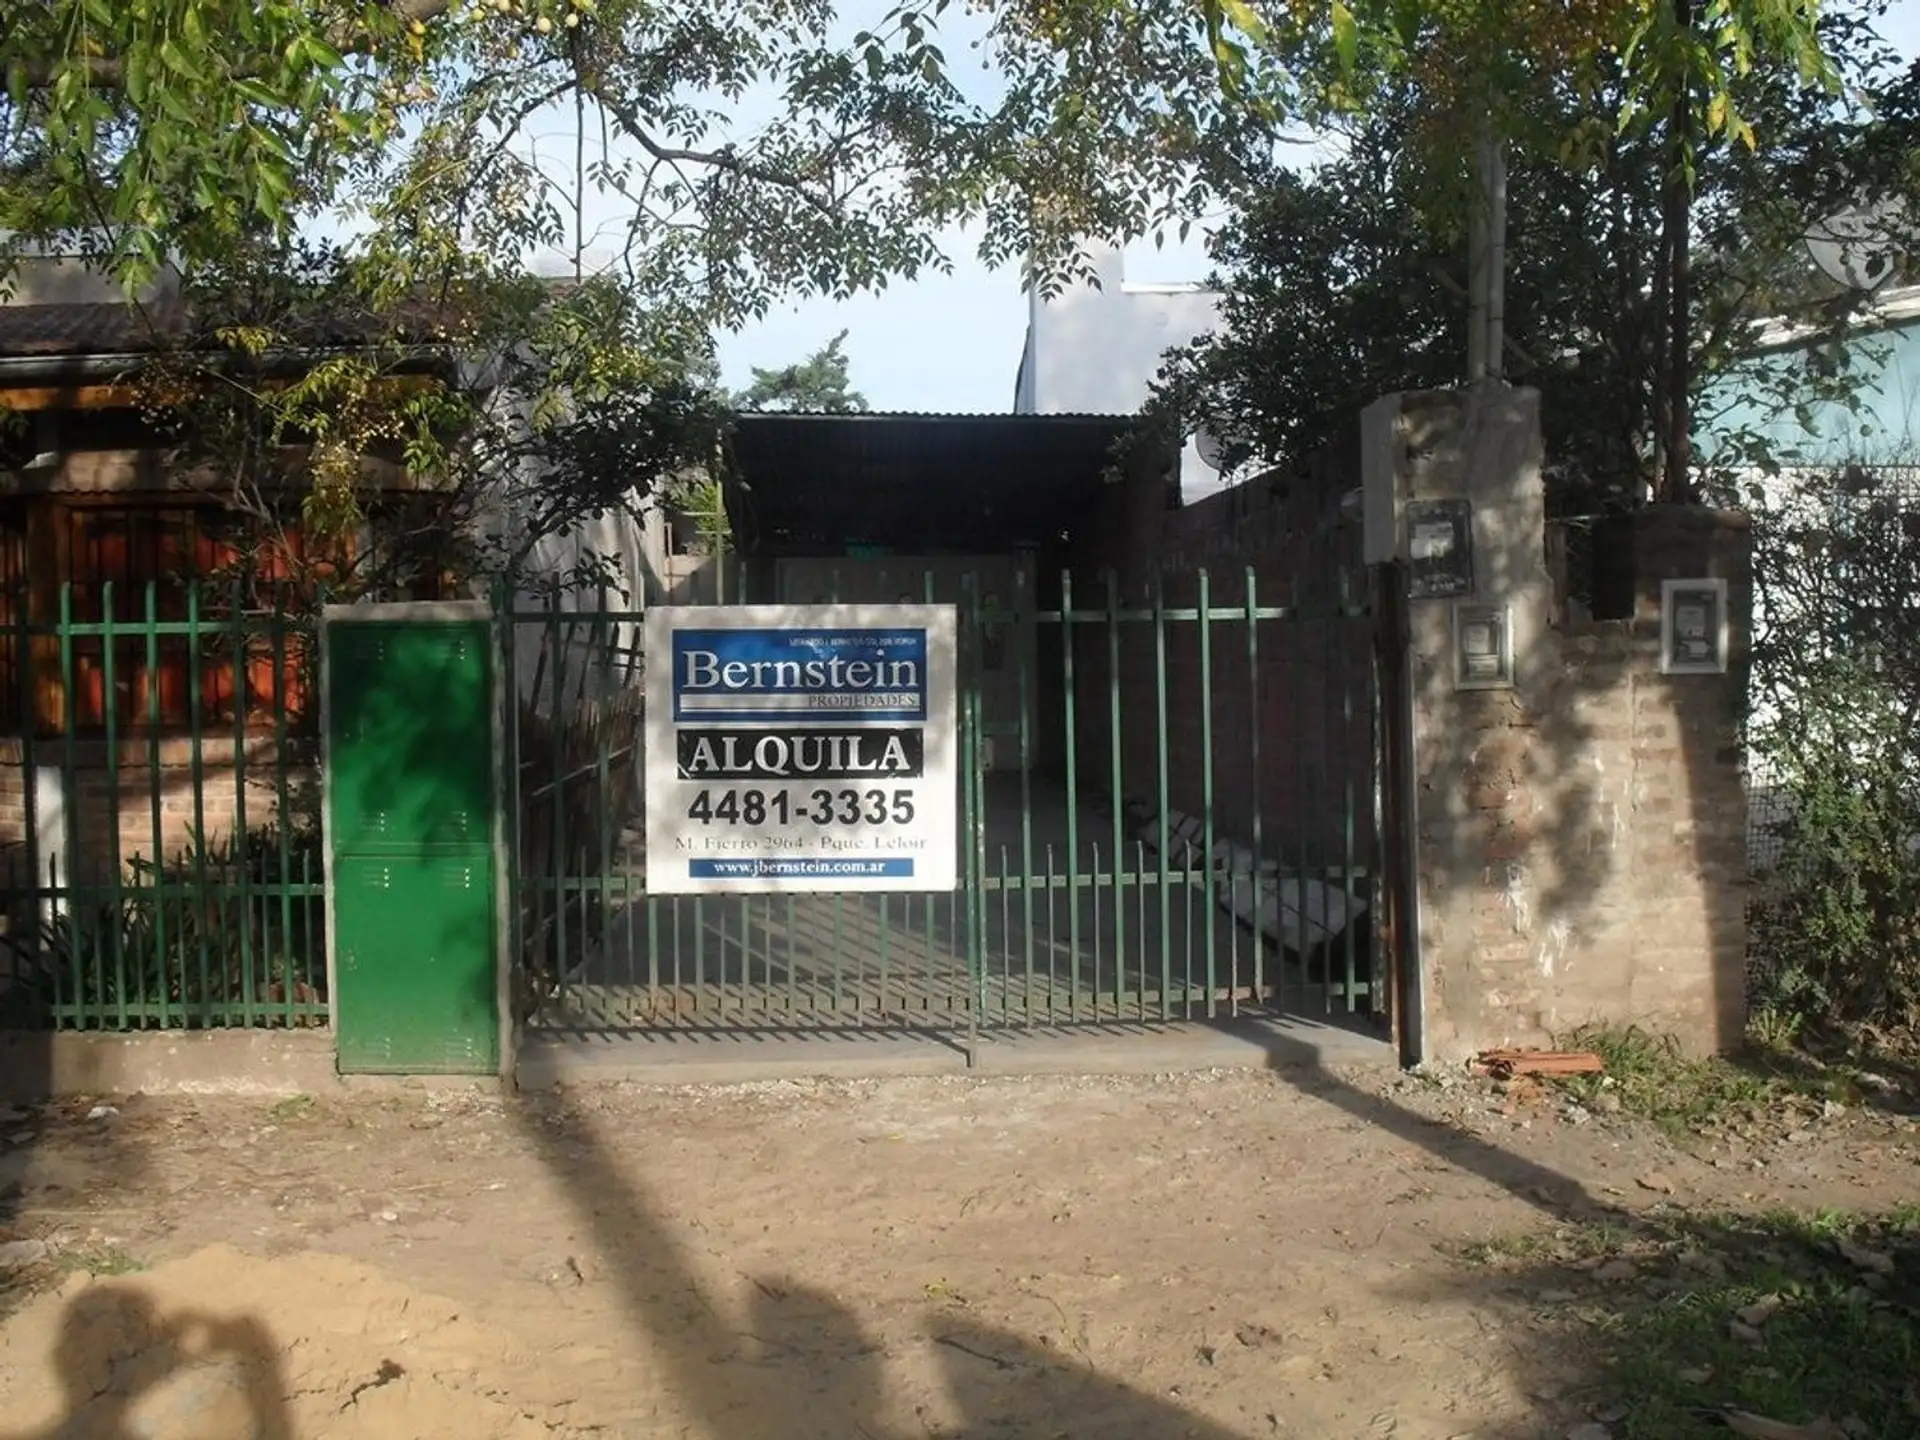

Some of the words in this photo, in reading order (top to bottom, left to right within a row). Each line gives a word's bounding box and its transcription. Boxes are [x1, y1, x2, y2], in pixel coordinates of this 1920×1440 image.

[682, 650, 919, 689] Bernstein
[808, 694, 917, 707] PROPIEDADES
[687, 734, 912, 775] ALQUILA
[688, 788, 916, 826] 4481-3335
[675, 836, 697, 850] M.
[704, 837, 758, 850] Fierro
[763, 837, 804, 850] 2964
[873, 836, 928, 850] Leloir
[713, 860, 886, 878] www.jbernstein.com.ar
